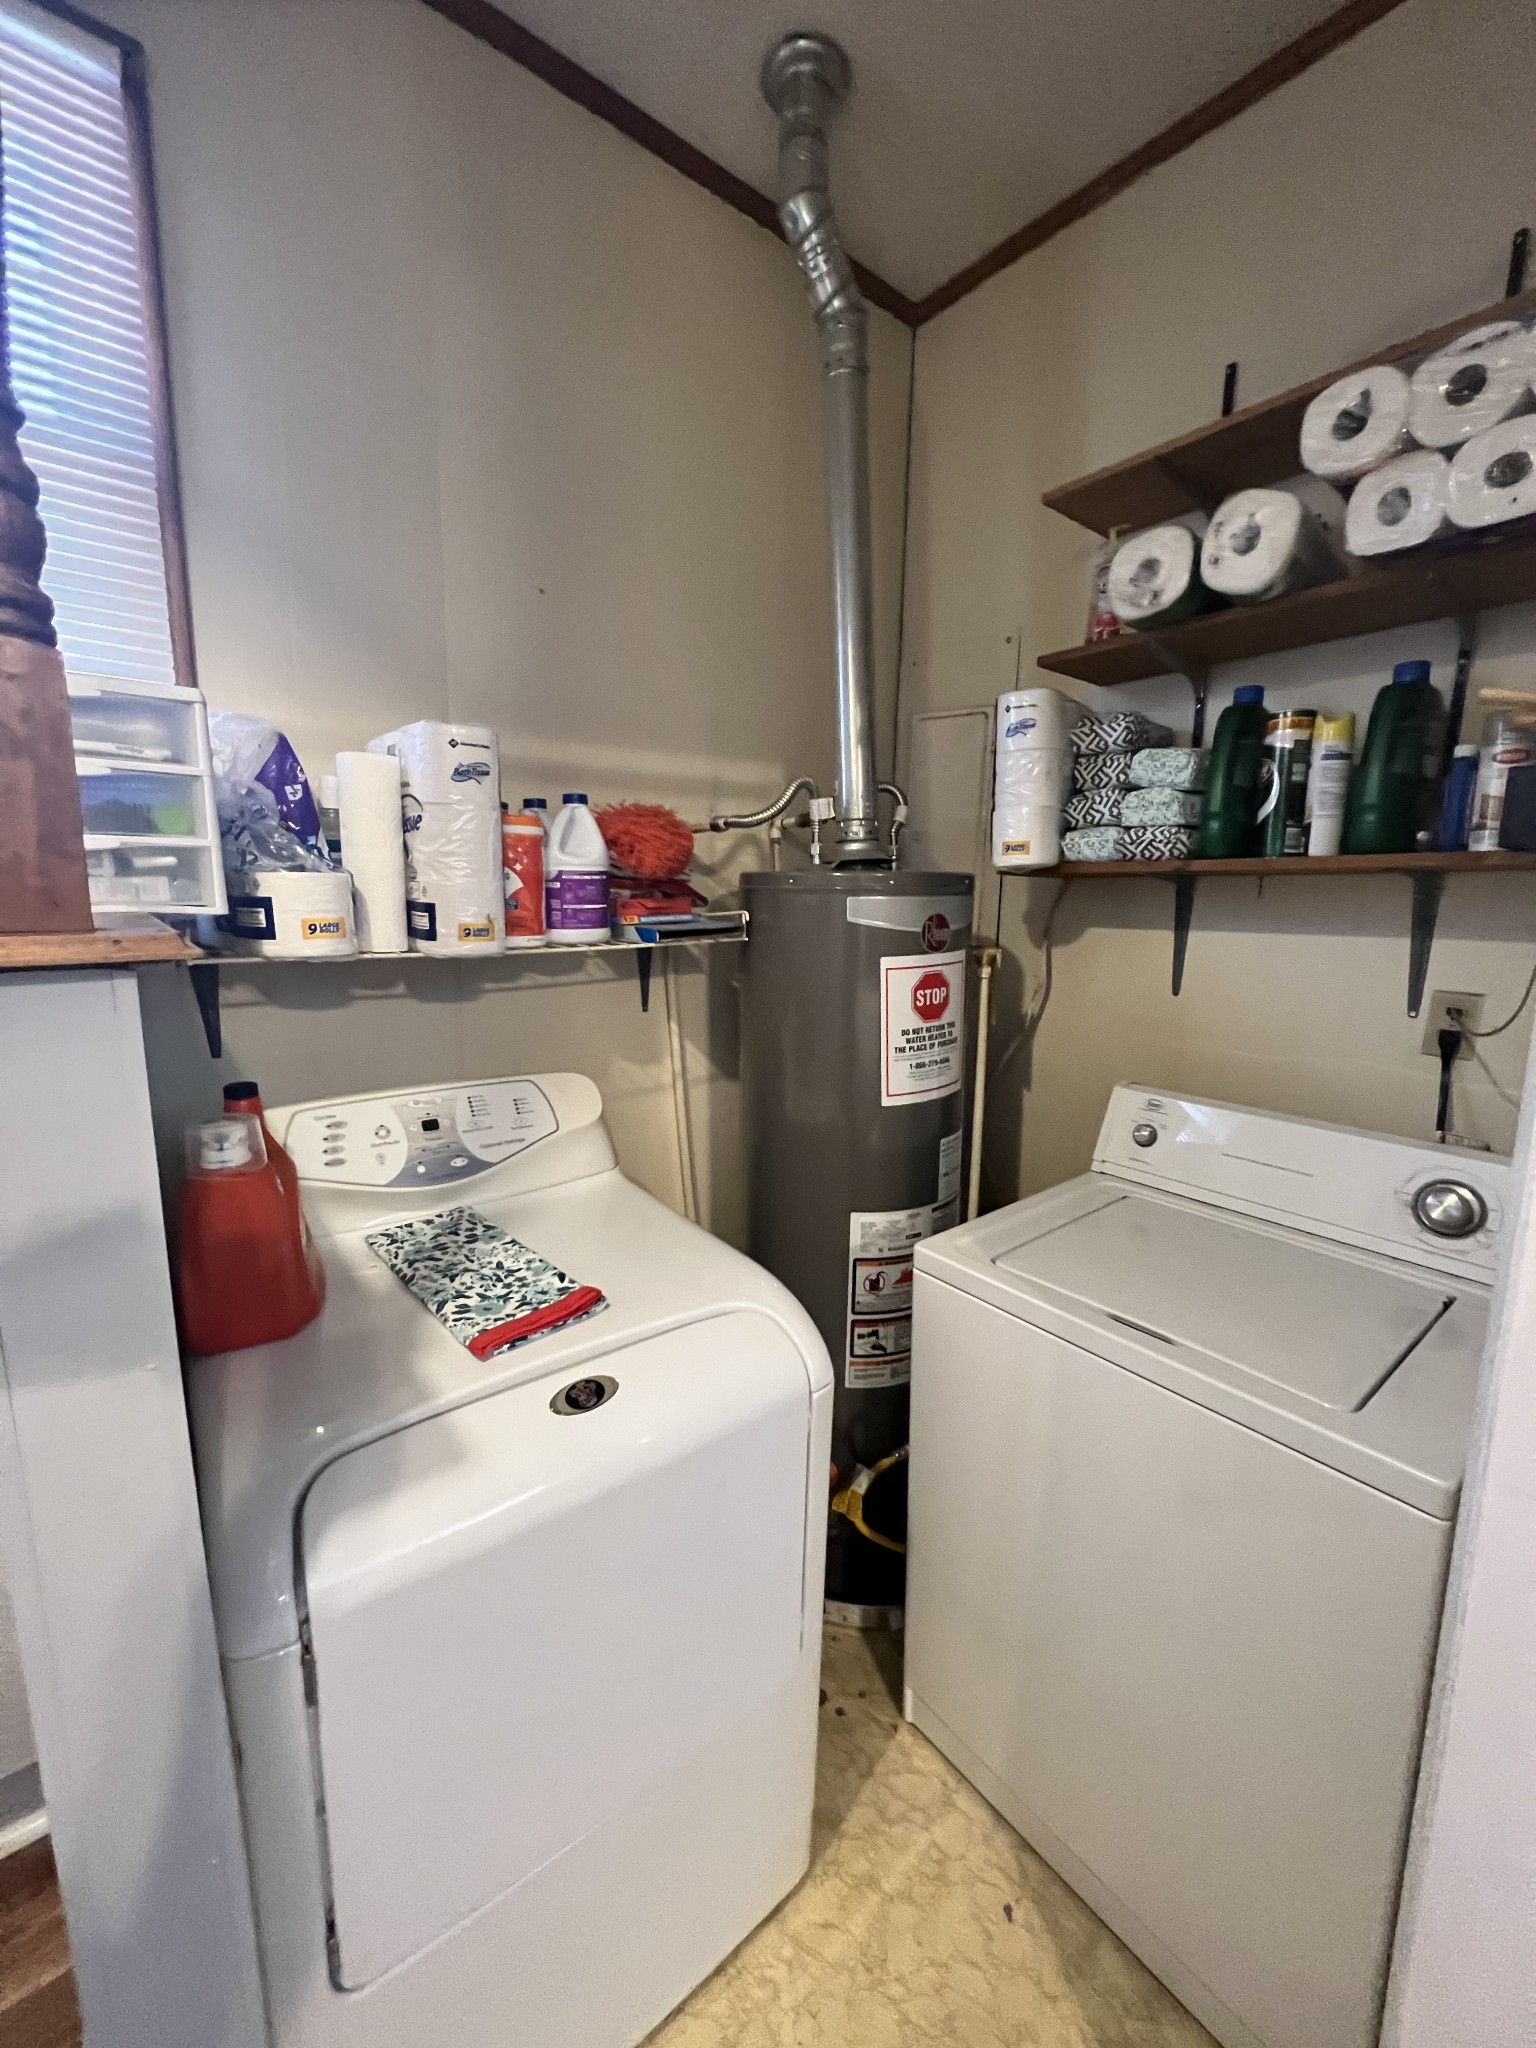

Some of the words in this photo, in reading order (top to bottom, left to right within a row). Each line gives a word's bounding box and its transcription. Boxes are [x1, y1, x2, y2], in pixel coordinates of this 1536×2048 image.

[308, 923, 318, 935] 9
[463, 927, 471, 937] 9
[916, 987, 947, 1007] STOP
[912, 1027, 924, 1035] NOT
[926, 1024, 945, 1033] RETURN
[906, 1035, 926, 1044] WATER
[928, 1032, 946, 1041] HEATER
[909, 1044, 927, 1052] PLACE
